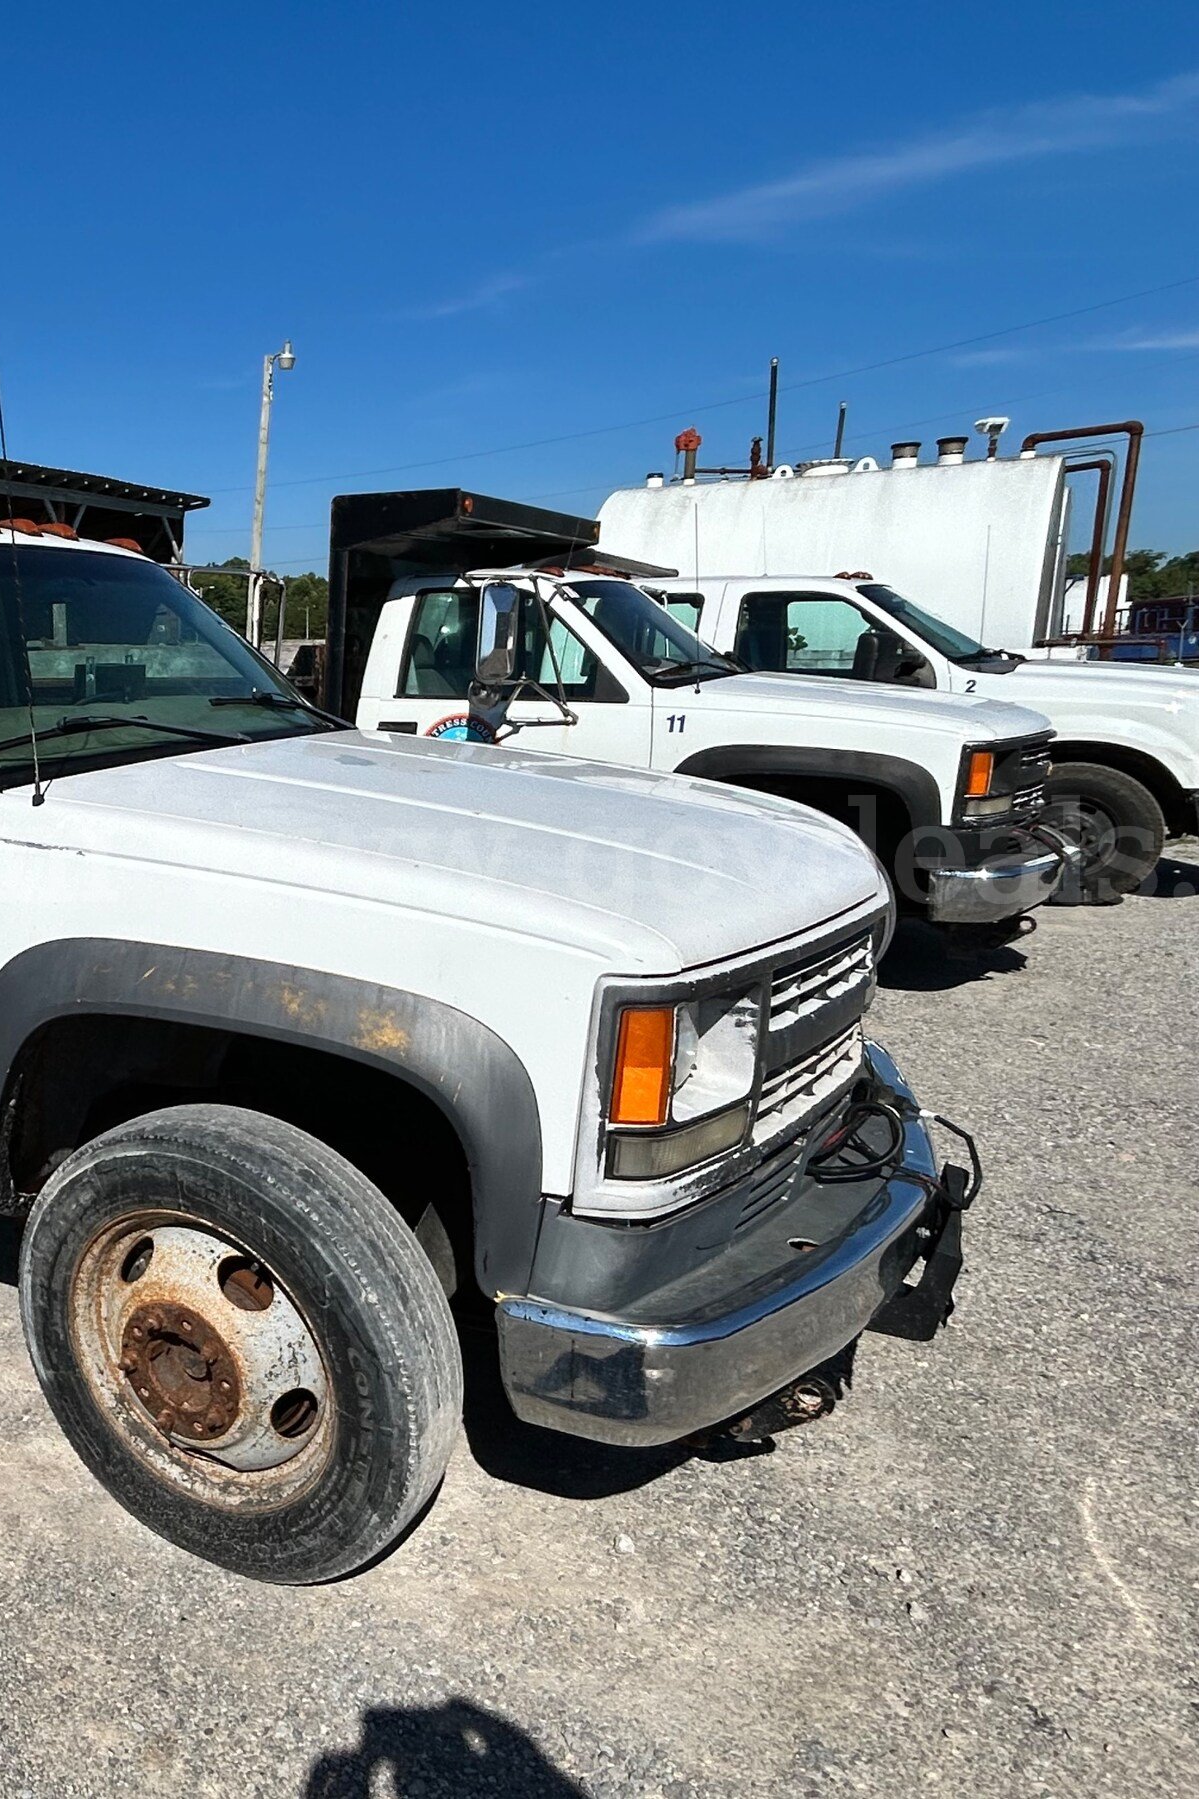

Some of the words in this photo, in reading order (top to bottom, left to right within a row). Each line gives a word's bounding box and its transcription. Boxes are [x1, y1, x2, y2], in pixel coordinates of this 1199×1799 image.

[965, 679, 977, 693] 2
[431, 718, 467, 737] TRESS
[470, 720, 492, 743] COU
[666, 714, 687, 733] 11
